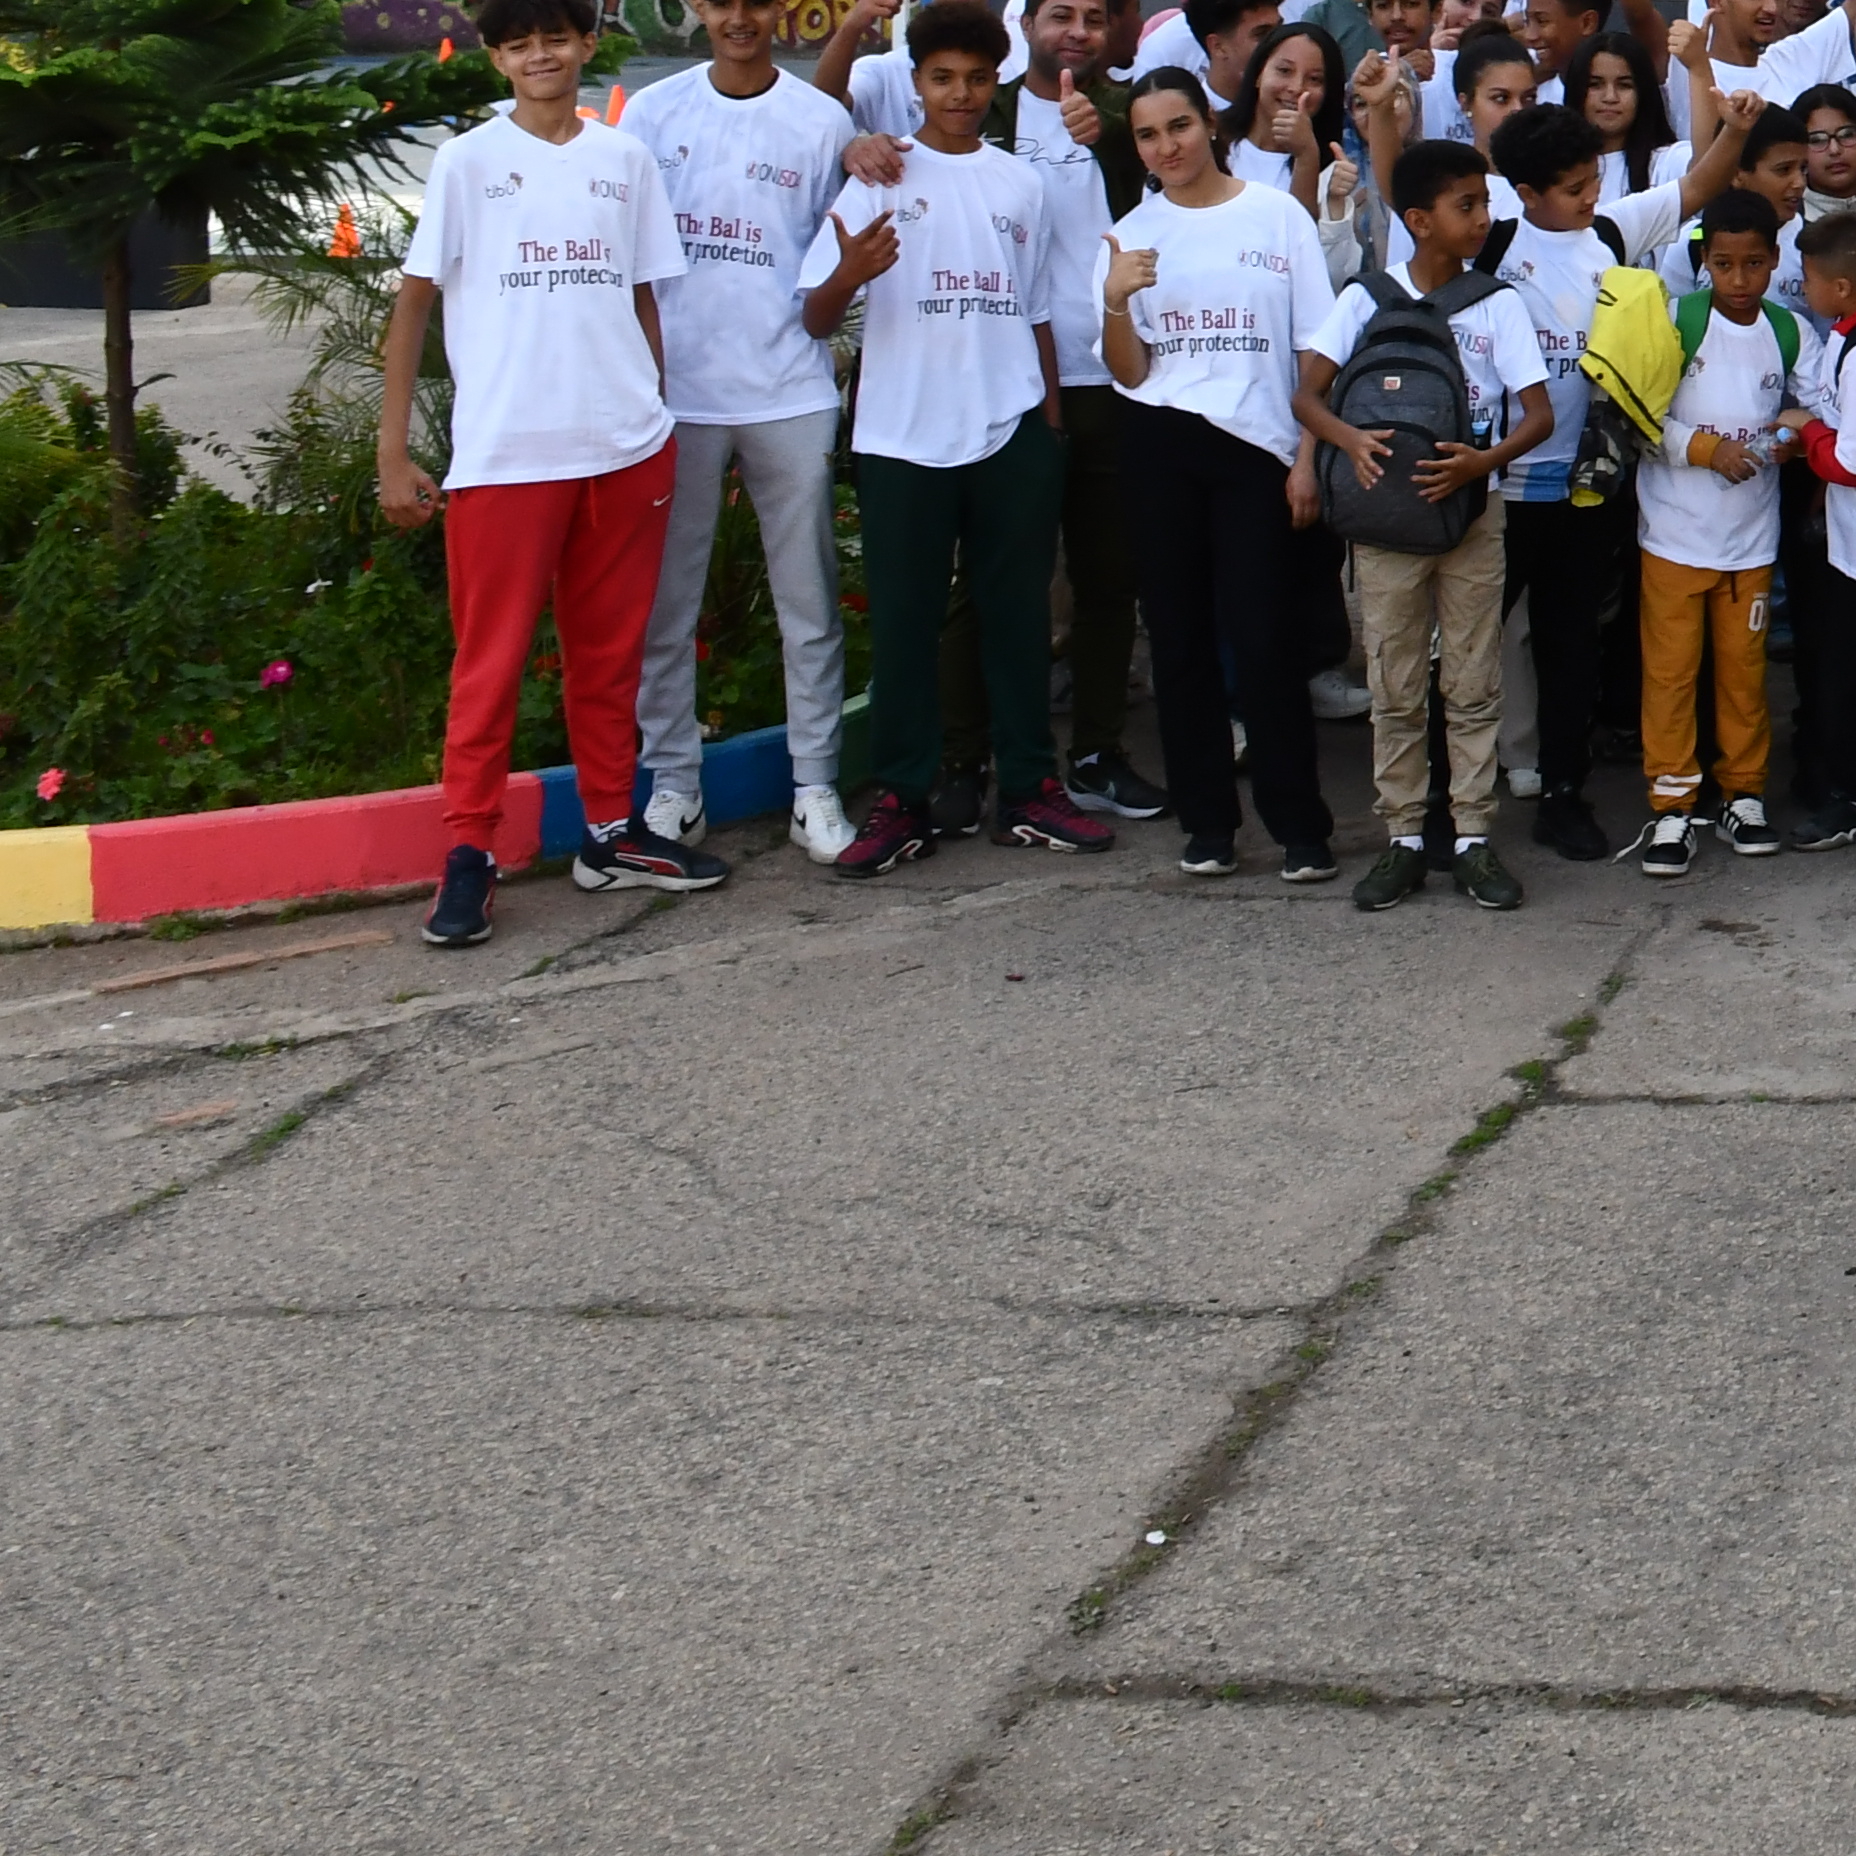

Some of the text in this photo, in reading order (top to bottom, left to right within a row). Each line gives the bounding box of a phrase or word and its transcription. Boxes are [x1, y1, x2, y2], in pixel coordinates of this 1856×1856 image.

[745, 222, 762, 243] is
[518, 240, 559, 263] The
[500, 268, 542, 295] your
[932, 269, 970, 291] The
[917, 296, 953, 321] your
[1160, 308, 1255, 332] The Ball is
[1157, 336, 1184, 356] our
